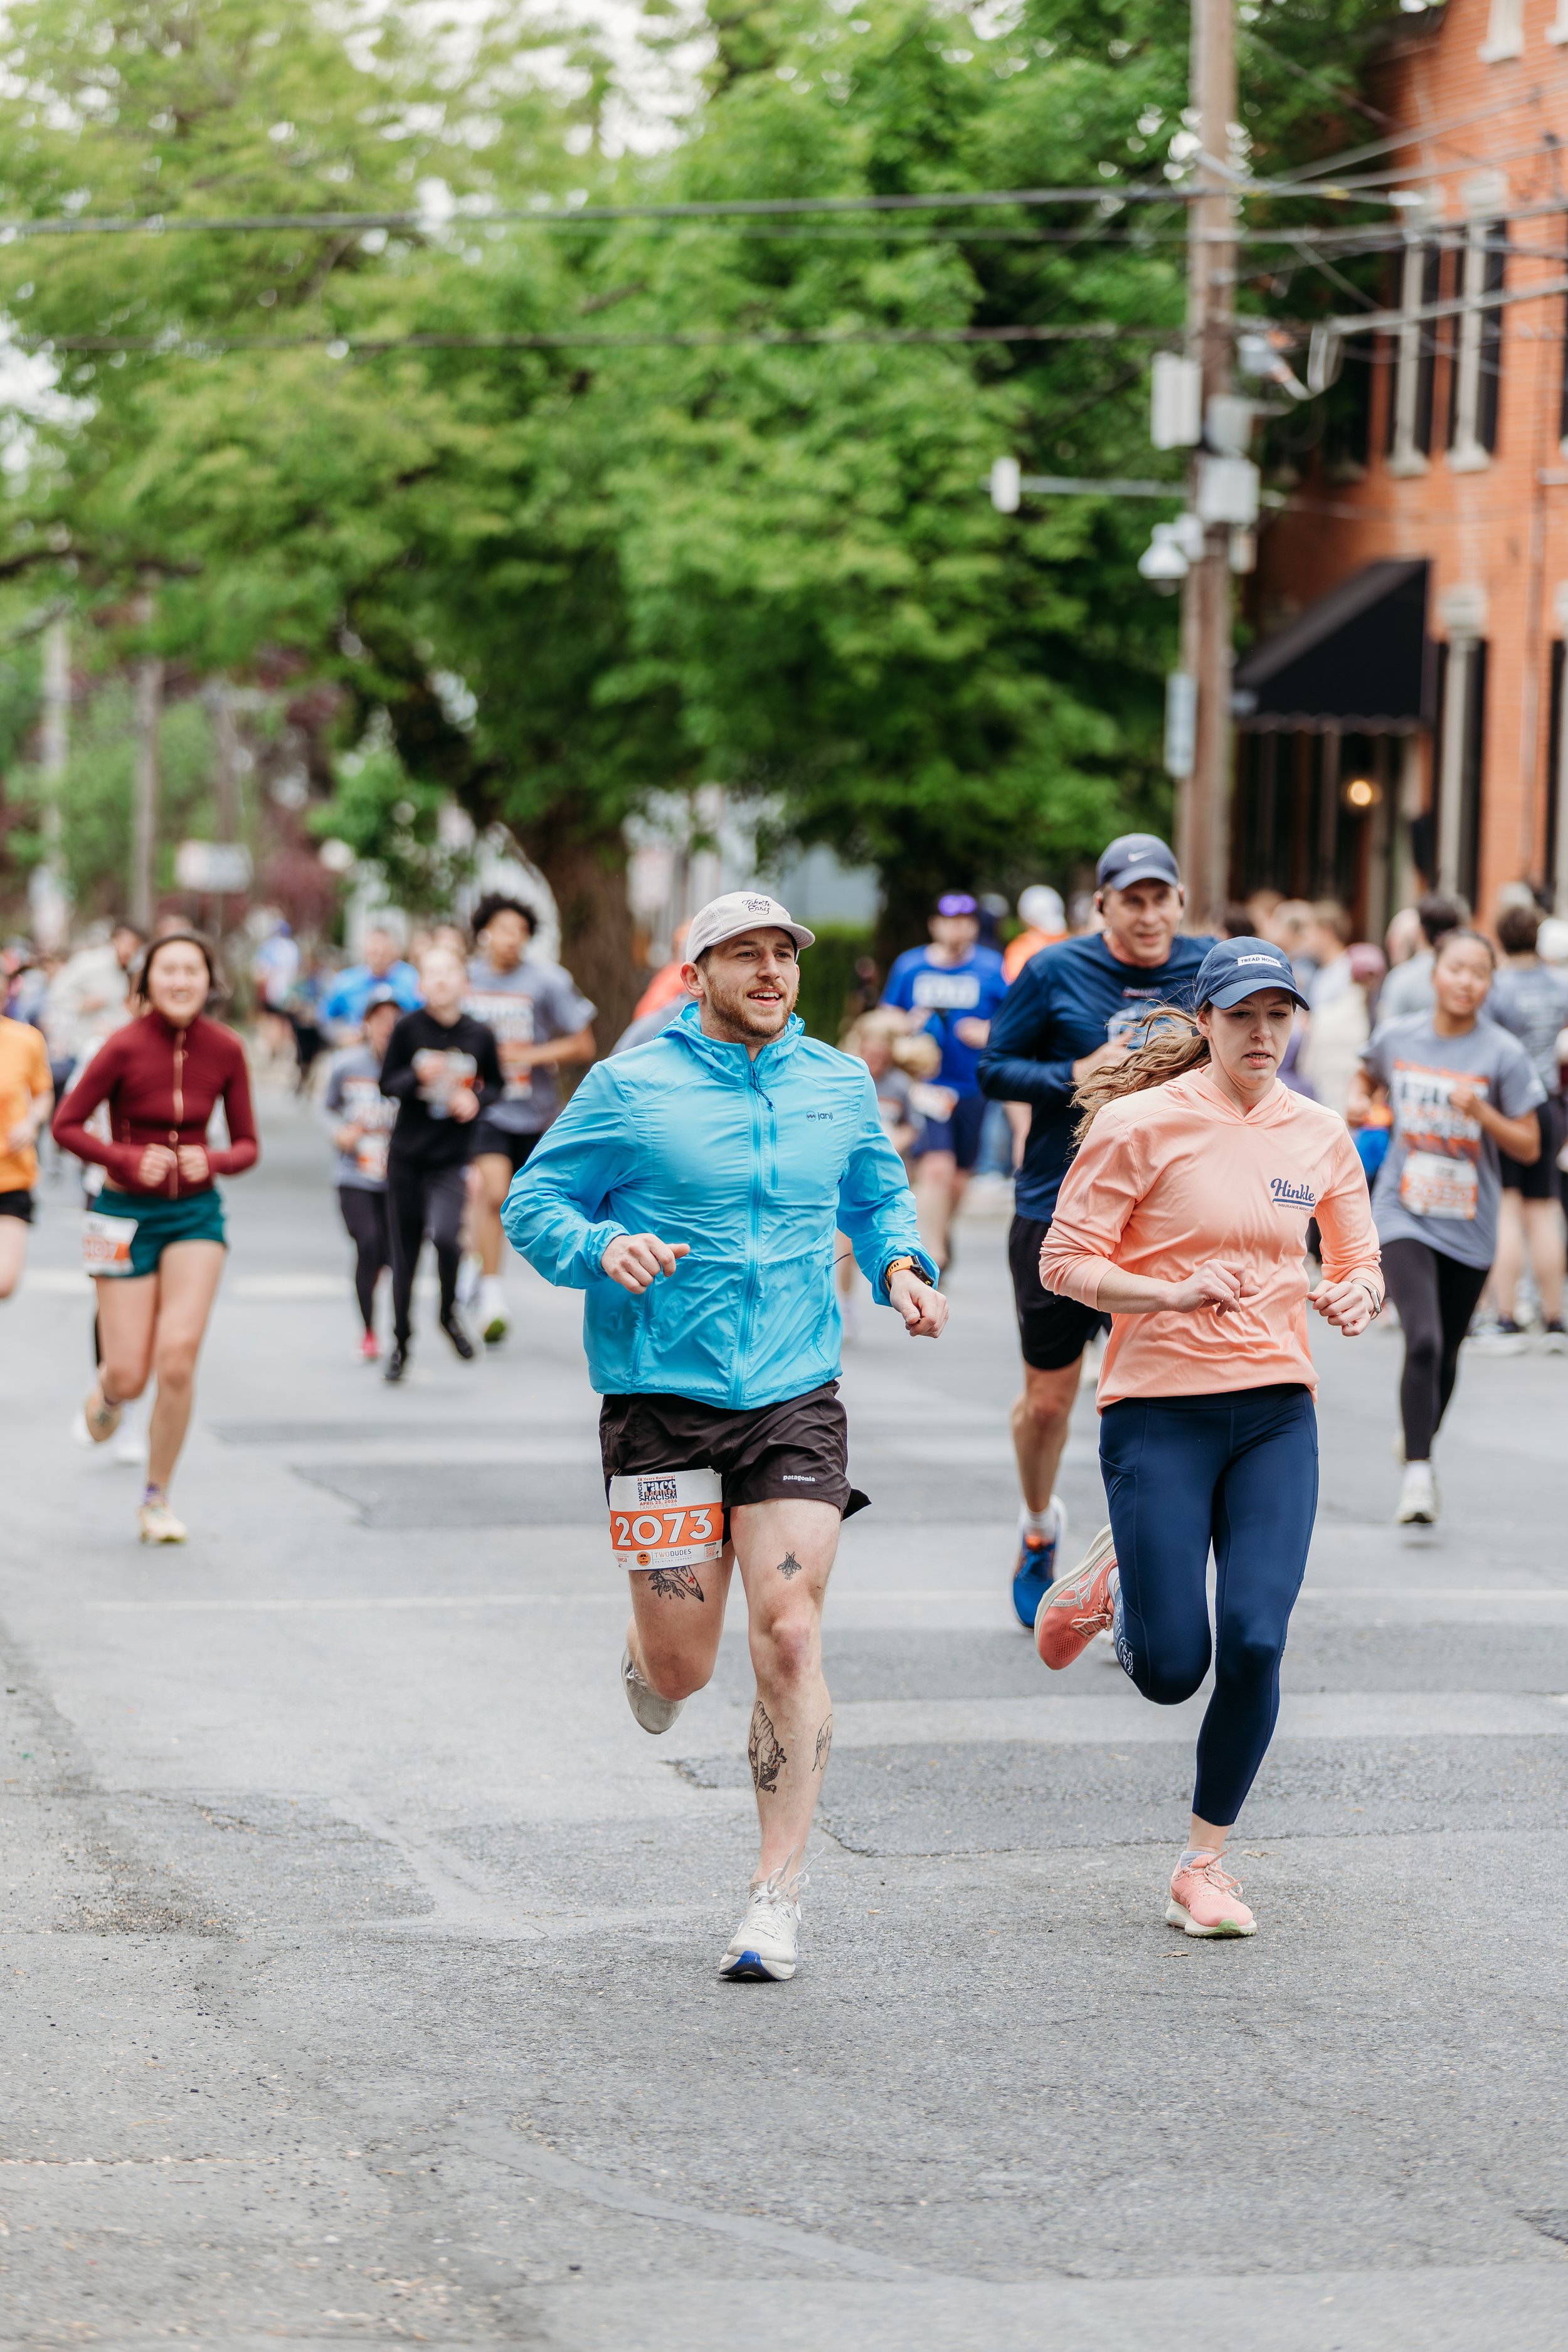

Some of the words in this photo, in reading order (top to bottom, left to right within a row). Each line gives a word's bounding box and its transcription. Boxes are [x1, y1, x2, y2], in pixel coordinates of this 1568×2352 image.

[748, 905, 770, 915] Easy
[817, 1112, 834, 1120] janji
[1270, 1178, 1316, 1202] Hinkle
[644, 1481, 676, 1491] race
[644, 1490, 677, 1502] RACISM
[615, 1508, 713, 1546] 2073
